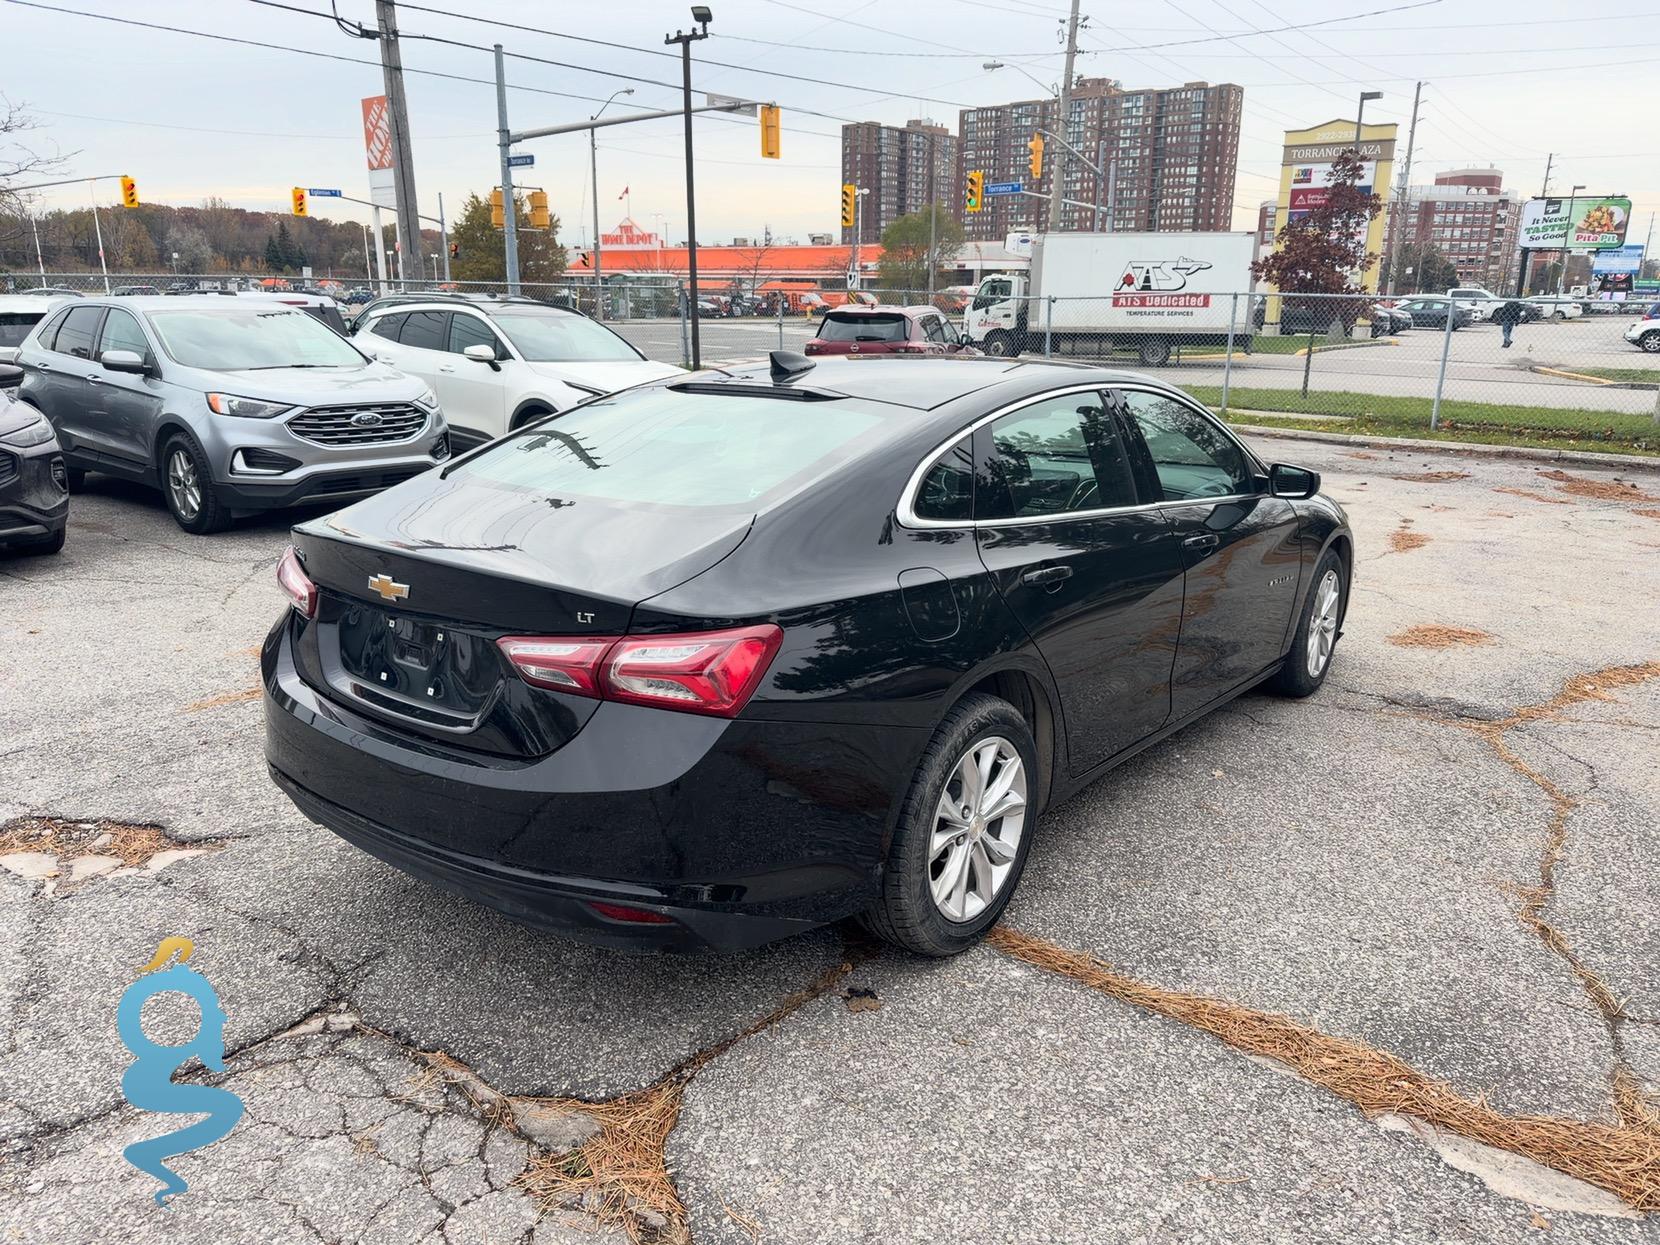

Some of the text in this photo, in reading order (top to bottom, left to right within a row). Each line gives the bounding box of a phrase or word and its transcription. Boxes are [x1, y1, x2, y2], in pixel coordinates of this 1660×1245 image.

[366, 101, 382, 133] THE
[367, 102, 390, 169] HOM
[1291, 146, 1347, 159] TORRANCE
[988, 185, 1012, 193] Torrance
[1531, 216, 1570, 225] It Never
[619, 225, 633, 234] THE
[1524, 222, 1575, 235] TASTED
[601, 233, 652, 245] HOME DEPOT
[1529, 230, 1569, 242] So Good
[1575, 233, 1618, 243] Pita Pit
[1118, 294, 1204, 307] ATS Dedicated
[577, 611, 595, 624] LT
